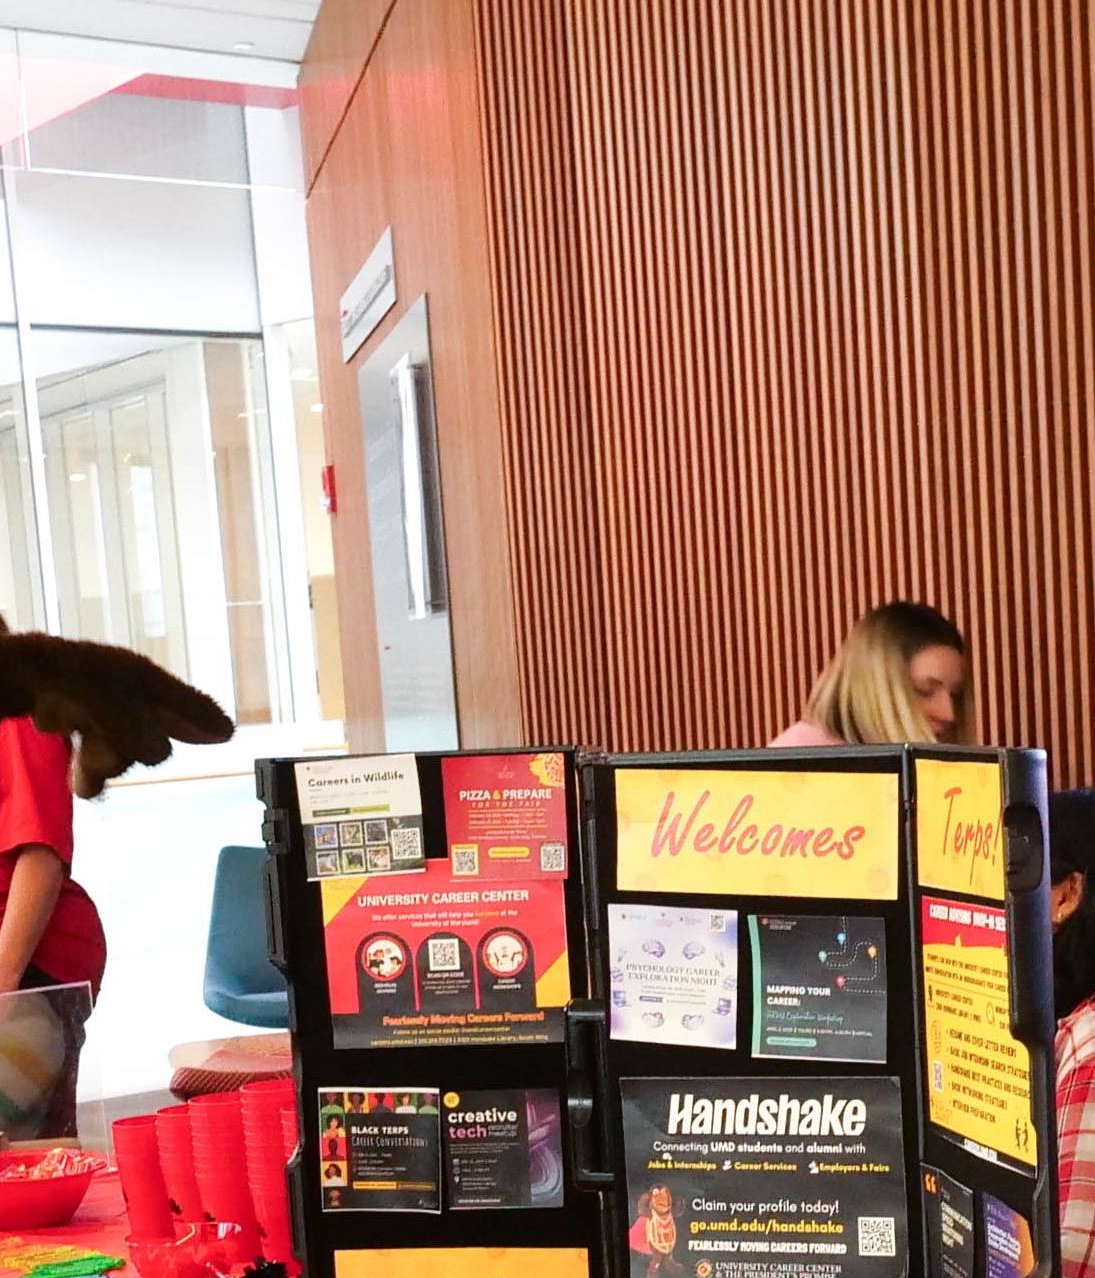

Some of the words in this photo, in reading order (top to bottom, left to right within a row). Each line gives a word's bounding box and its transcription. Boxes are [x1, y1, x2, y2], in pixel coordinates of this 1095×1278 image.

[308, 776, 348, 787] Careers
[351, 774, 361, 784] in
[364, 771, 405, 782] Wildlife
[459, 789, 491, 801] PIZZA
[493, 789, 502, 800] &
[502, 787, 553, 800] PREPARE
[650, 789, 866, 860] Welcomes
[943, 787, 1004, 886] Terps!
[357, 893, 430, 908] UNIVERSITY
[431, 891, 479, 905] CAREER
[481, 890, 529, 902] CENTER
[625, 963, 684, 975] PSYCHOLOGY
[686, 966, 721, 977] CAREER
[628, 971, 689, 983] EXPLORATION
[690, 977, 718, 986] NIGHT
[766, 985, 806, 996] MAPPING
[807, 986, 831, 997] YOUR
[766, 996, 801, 1007] CAREER:
[447, 1107, 518, 1123] creative
[667, 1093, 867, 1136] Handshake
[351, 1126, 379, 1135] BLACK
[381, 1126, 409, 1135] TERPS
[449, 1124, 487, 1138] tech
[653, 1141, 708, 1154] Connecting
[710, 1142, 735, 1153] UMD
[737, 1142, 782, 1153] students
[785, 1143, 804, 1153] and
[806, 1143, 842, 1153] alumni
[844, 1144, 866, 1154] with
[647, 1161, 666, 1170] Jobs
[674, 1161, 717, 1171] Internships
[734, 1162, 762, 1170] Career
[763, 1162, 798, 1171] Services
[819, 1163, 861, 1173] Employers
[869, 1164, 890, 1173] Fairs
[691, 1198, 727, 1211] Claim
[729, 1202, 755, 1215] your
[758, 1199, 797, 1214] profile
[800, 1200, 840, 1216] today!
[690, 1218, 844, 1235] go.umd.edu/handshake
[688, 1240, 739, 1251] FEARLESSLY
[740, 1241, 769, 1252] MOVING
[770, 1242, 808, 1254] CAREERS
[809, 1243, 847, 1255] FORWARD
[715, 1262, 768, 1271] UNIVERSITY
[769, 1263, 805, 1273] CAREER
[806, 1264, 842, 1274] CENTER
[725, 1271, 741, 1278] THE
